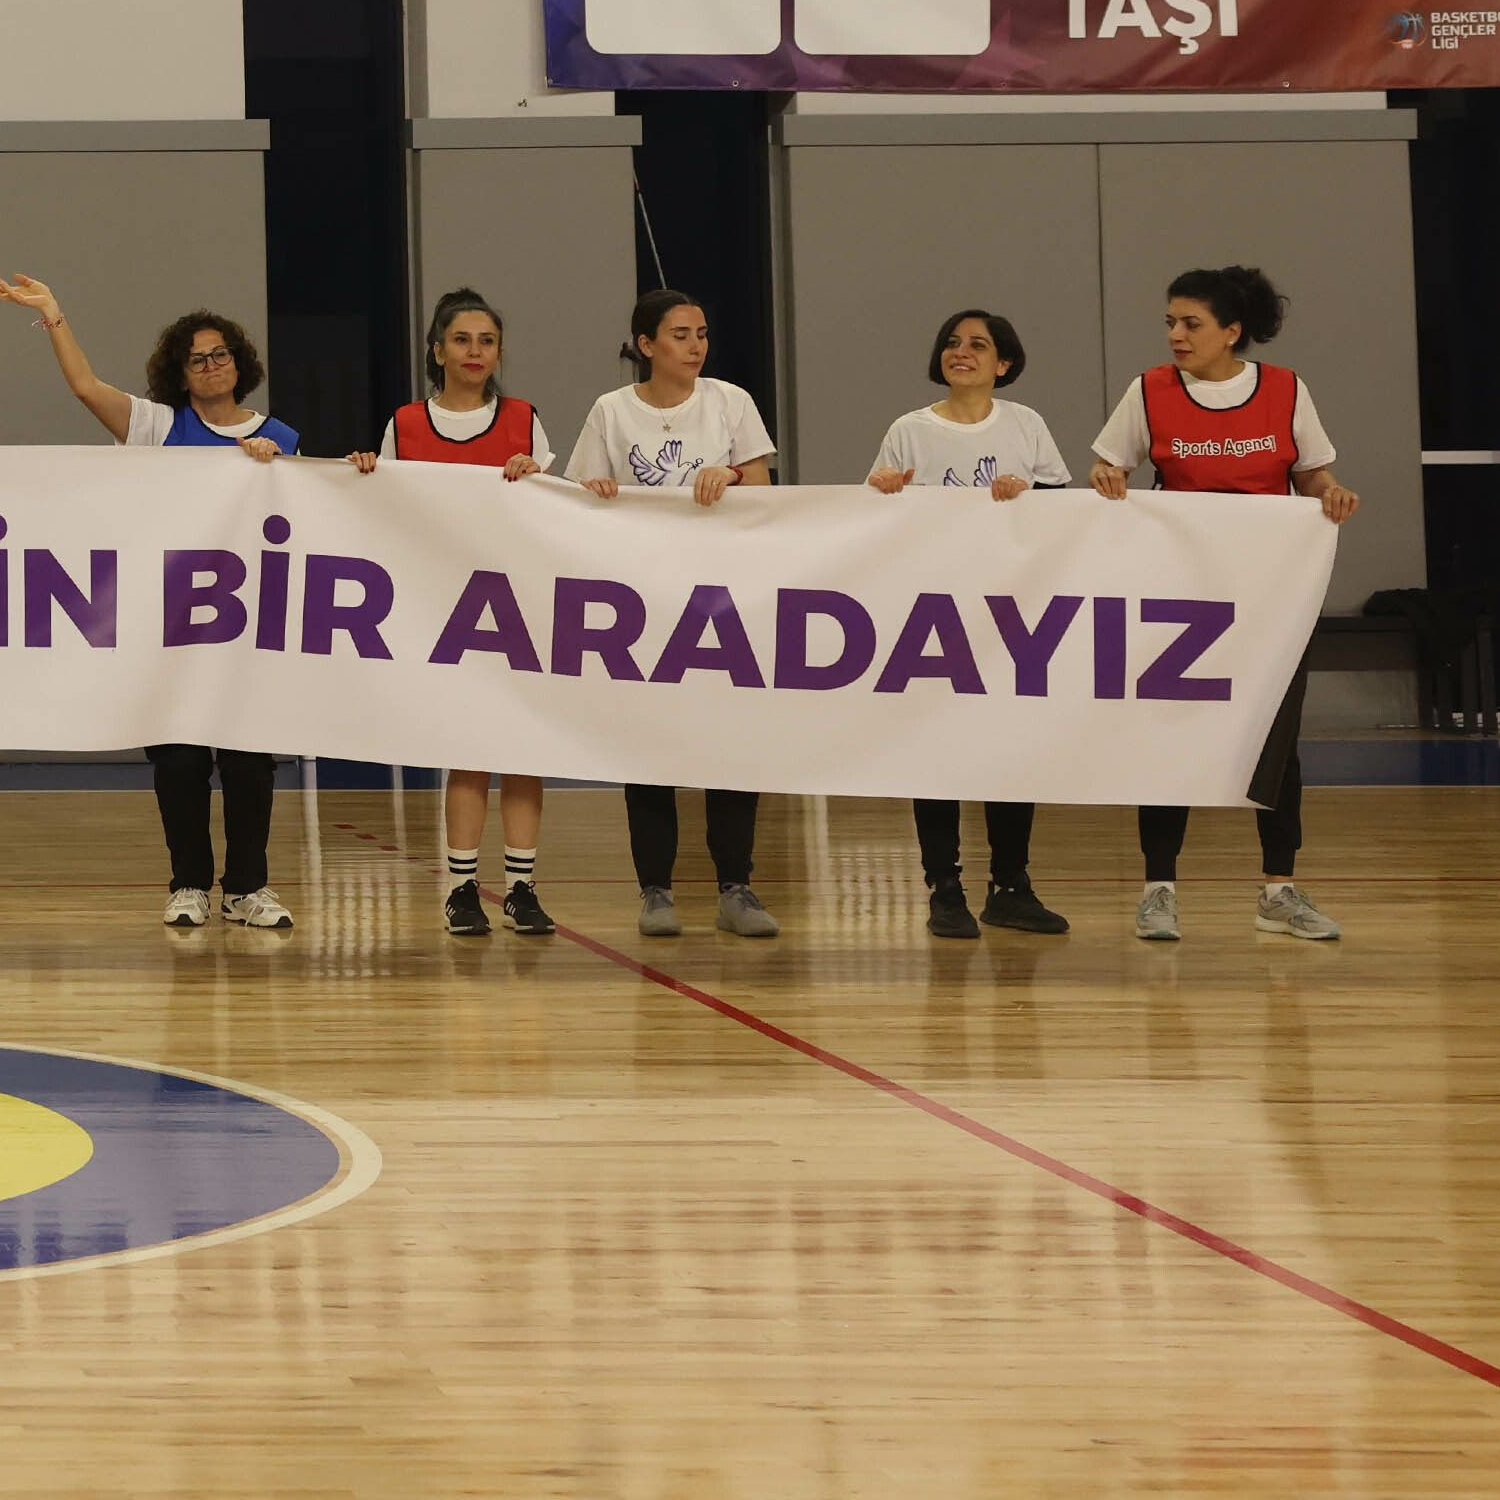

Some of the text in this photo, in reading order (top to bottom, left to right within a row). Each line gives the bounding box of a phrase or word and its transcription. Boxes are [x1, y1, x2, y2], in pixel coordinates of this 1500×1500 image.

[1431, 11, 1500, 23] BASKETB
[1432, 24, 1496, 39] GENÇLER
[1432, 36, 1459, 49] LİGİ
[1172, 438, 1221, 458] Sports
[162, 514, 395, 660] BİR
[428, 569, 1236, 700] ARADAYIZ
